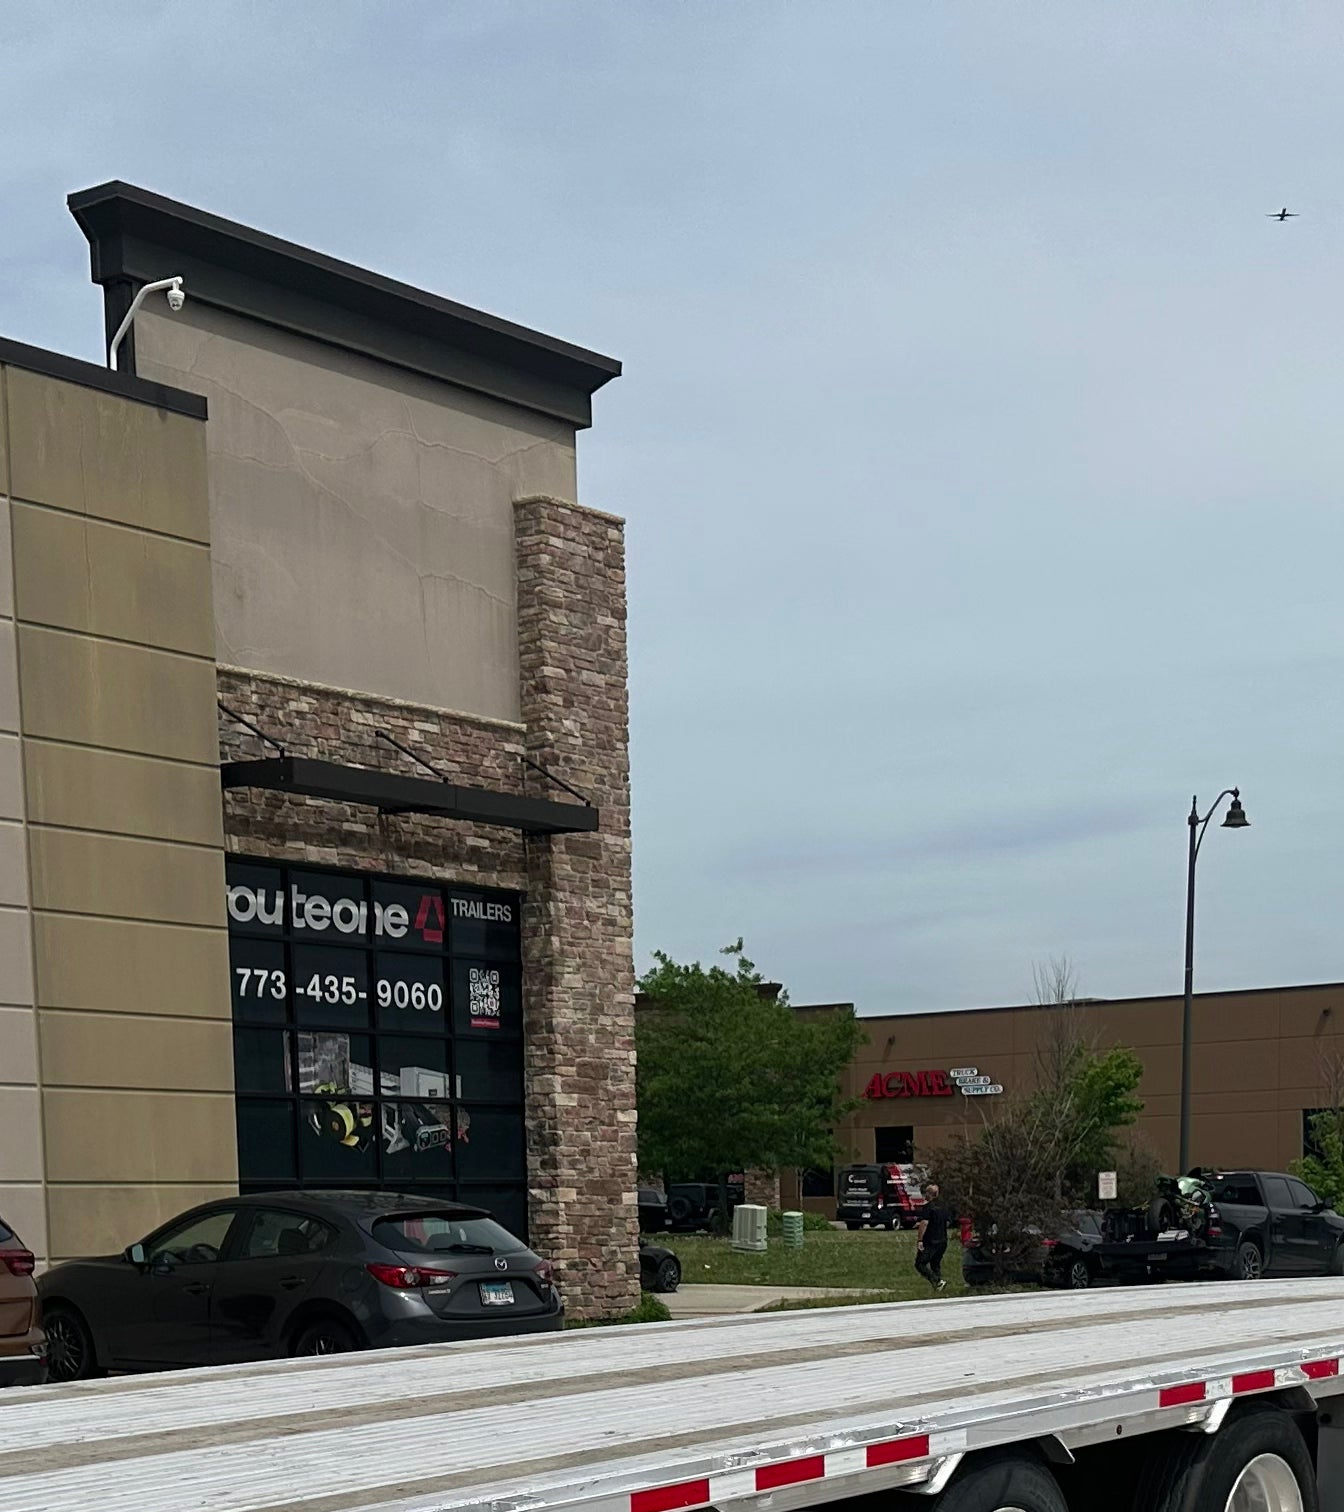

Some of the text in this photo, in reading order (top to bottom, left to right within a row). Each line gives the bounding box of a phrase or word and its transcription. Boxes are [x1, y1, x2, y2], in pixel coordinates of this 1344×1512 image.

[451, 898, 512, 922] TRAILERS
[236, 967, 443, 1012] 773-435-9060
[862, 1069, 953, 1099] ACME
